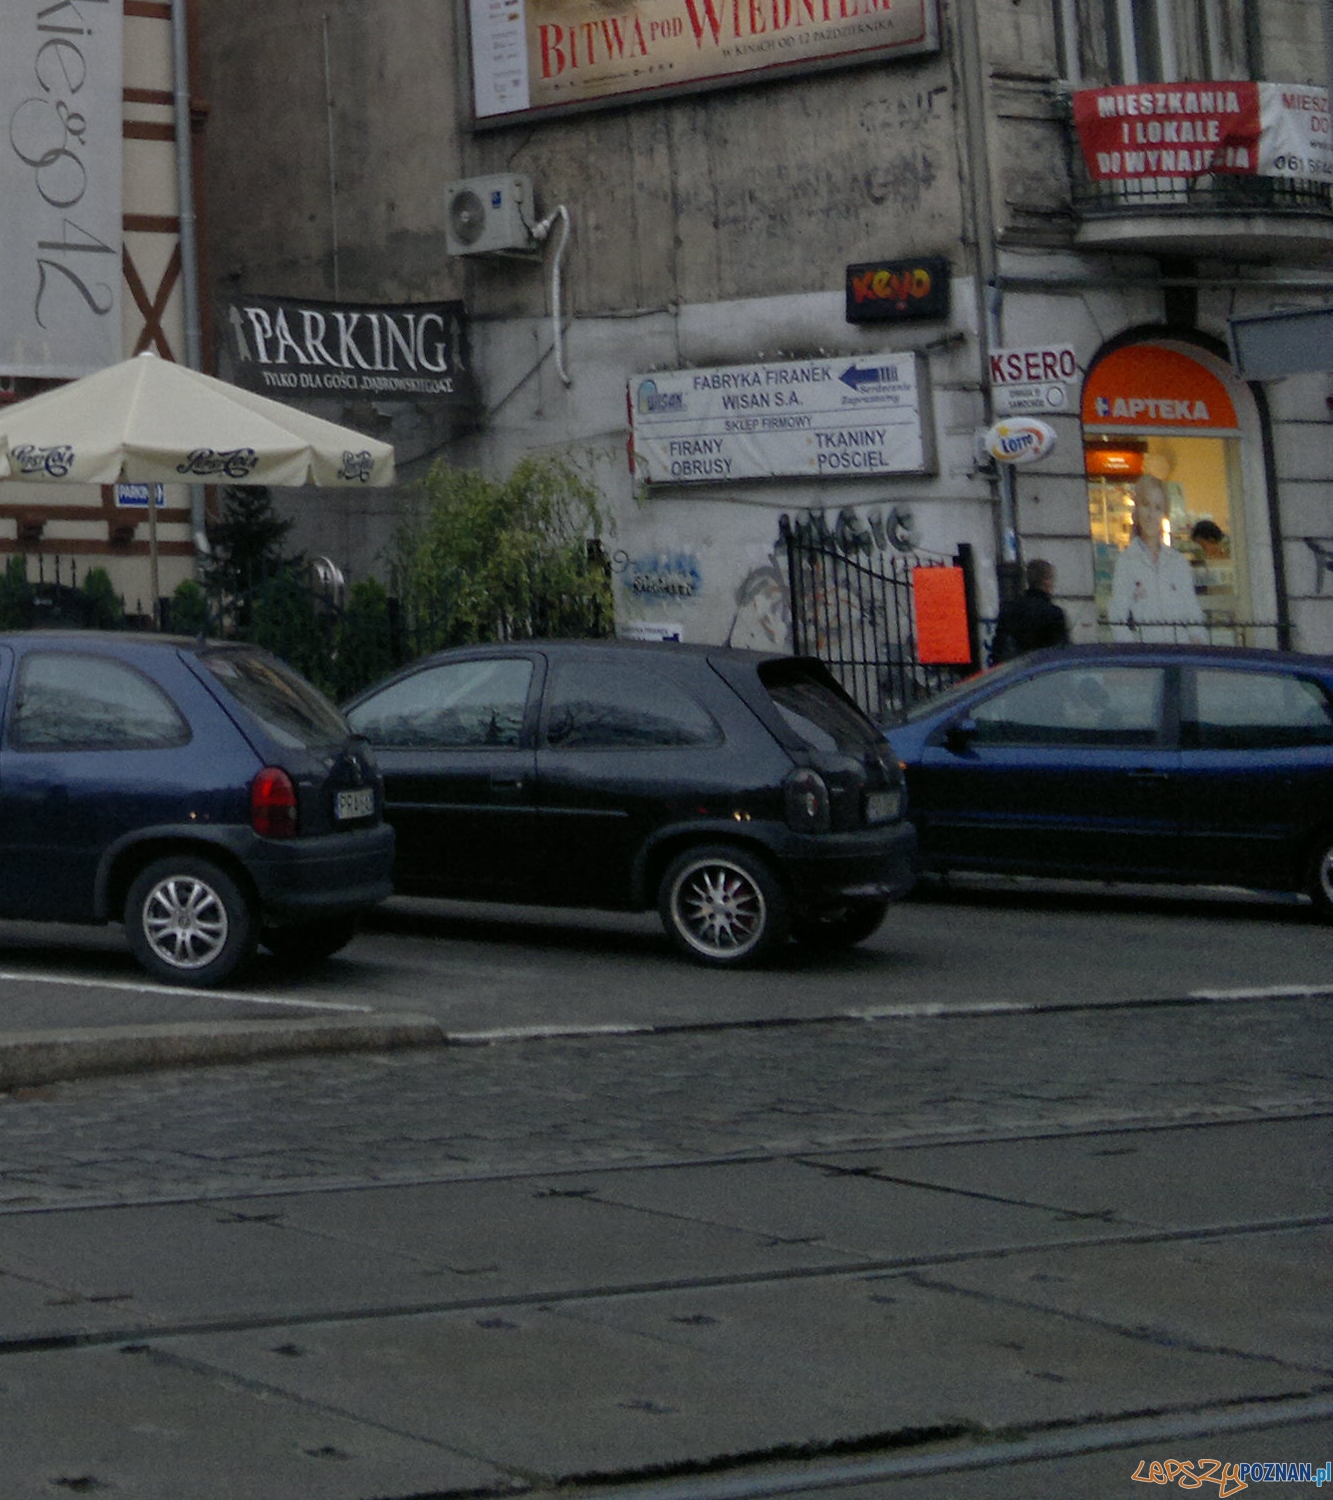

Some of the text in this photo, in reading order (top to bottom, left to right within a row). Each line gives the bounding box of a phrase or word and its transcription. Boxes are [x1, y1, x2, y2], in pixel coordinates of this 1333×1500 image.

[539, 14, 648, 80] BITWA
[650, 17, 683, 42] POD
[1097, 92, 1240, 117] MIESZKANIA
[1122, 120, 1221, 144] I LOKALE
[1097, 152, 1121, 174] DO
[243, 307, 447, 373] PARKING
[991, 350, 1076, 383] KSERO
[263, 371, 298, 388] TYLKO
[300, 372, 323, 389] DLA
[324, 371, 358, 390] GOŚCI
[693, 366, 833, 390] FABRYKA FIRANEK
[722, 390, 804, 411] WISAN S.A.
[1113, 398, 1210, 420] APTEKA
[724, 415, 813, 432] SKLEP FIRMOWY
[669, 438, 724, 457] FIRANY
[814, 429, 887, 449] TKANINY
[670, 458, 733, 477] OBRUSY
[817, 450, 890, 471] POŚCIEL
